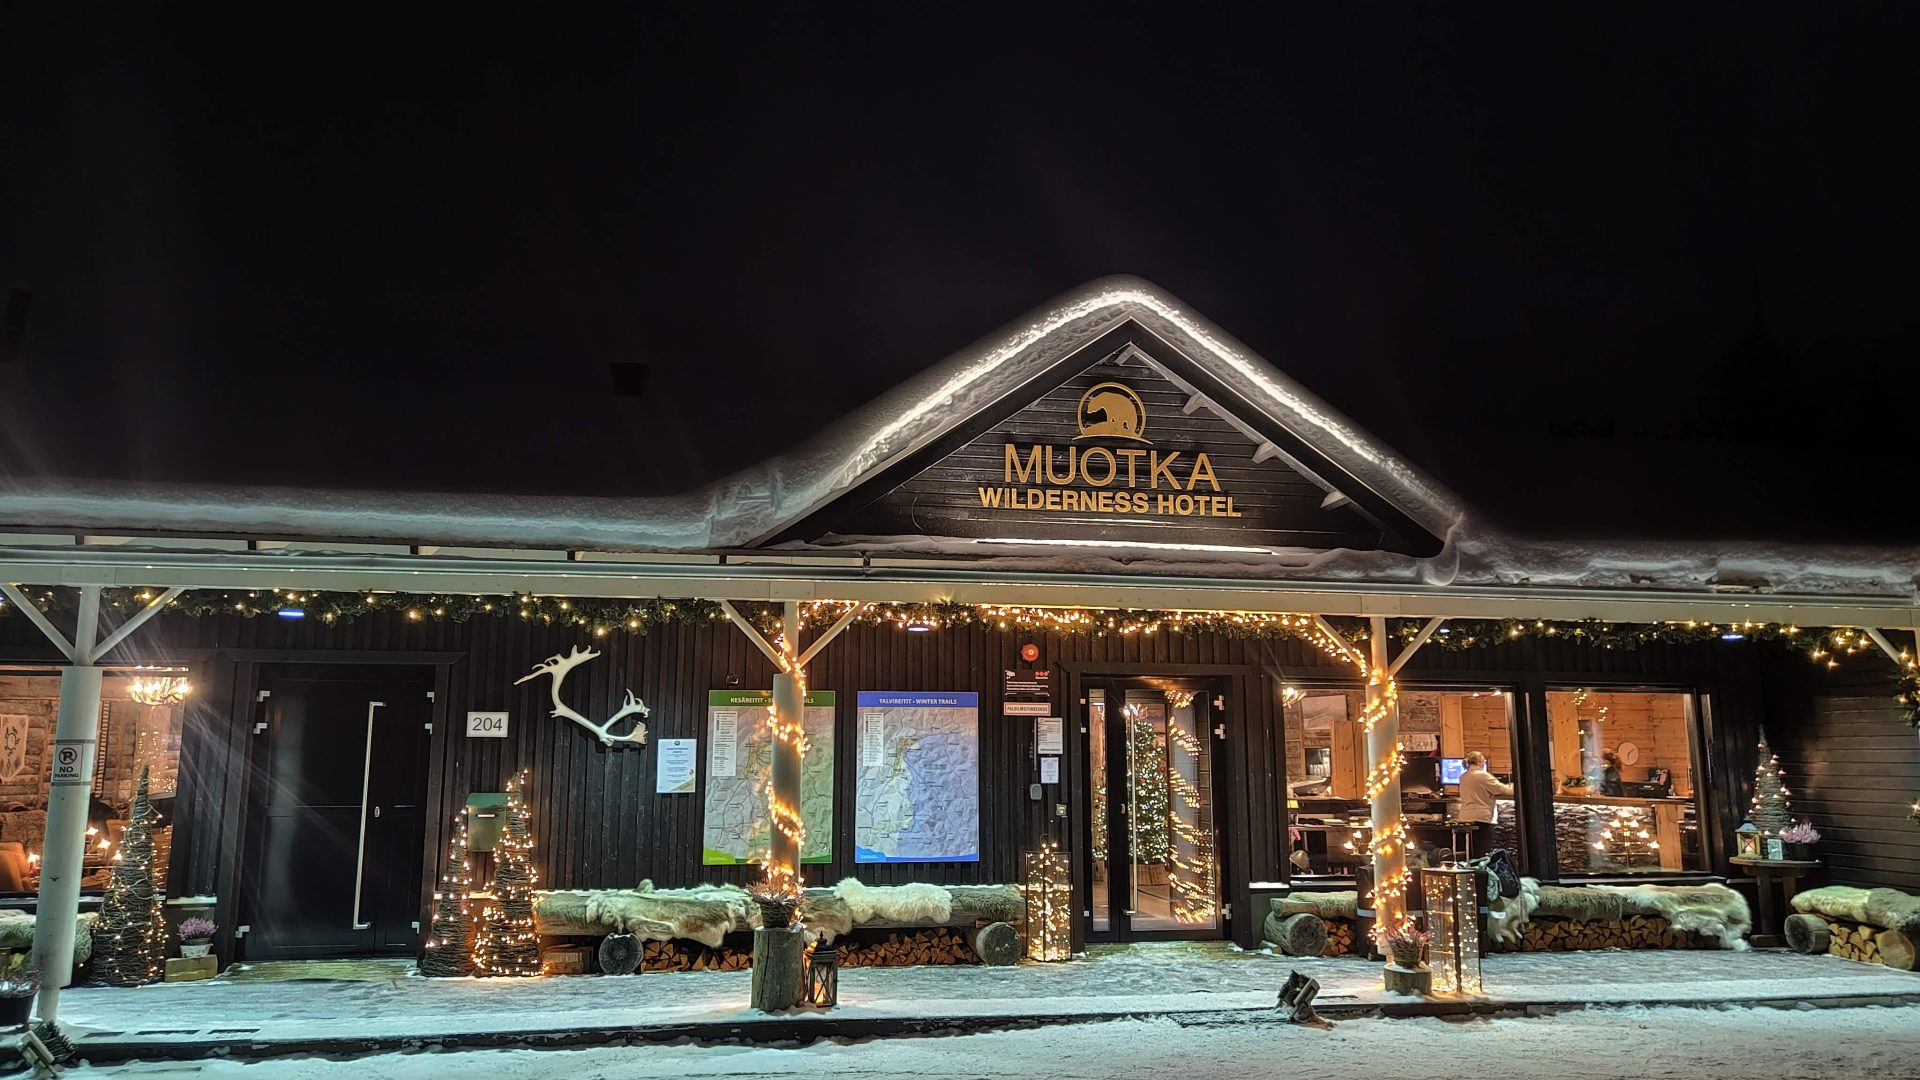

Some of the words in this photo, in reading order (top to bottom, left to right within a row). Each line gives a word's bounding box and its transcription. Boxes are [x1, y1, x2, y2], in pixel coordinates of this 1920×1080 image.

[1004, 444, 1221, 491] MUOTKA
[978, 487, 1149, 513] WILDERNESS
[1158, 494, 1242, 518] HOTEL
[730, 696, 763, 704] KESÄREITIT
[472, 717, 503, 732] 204
